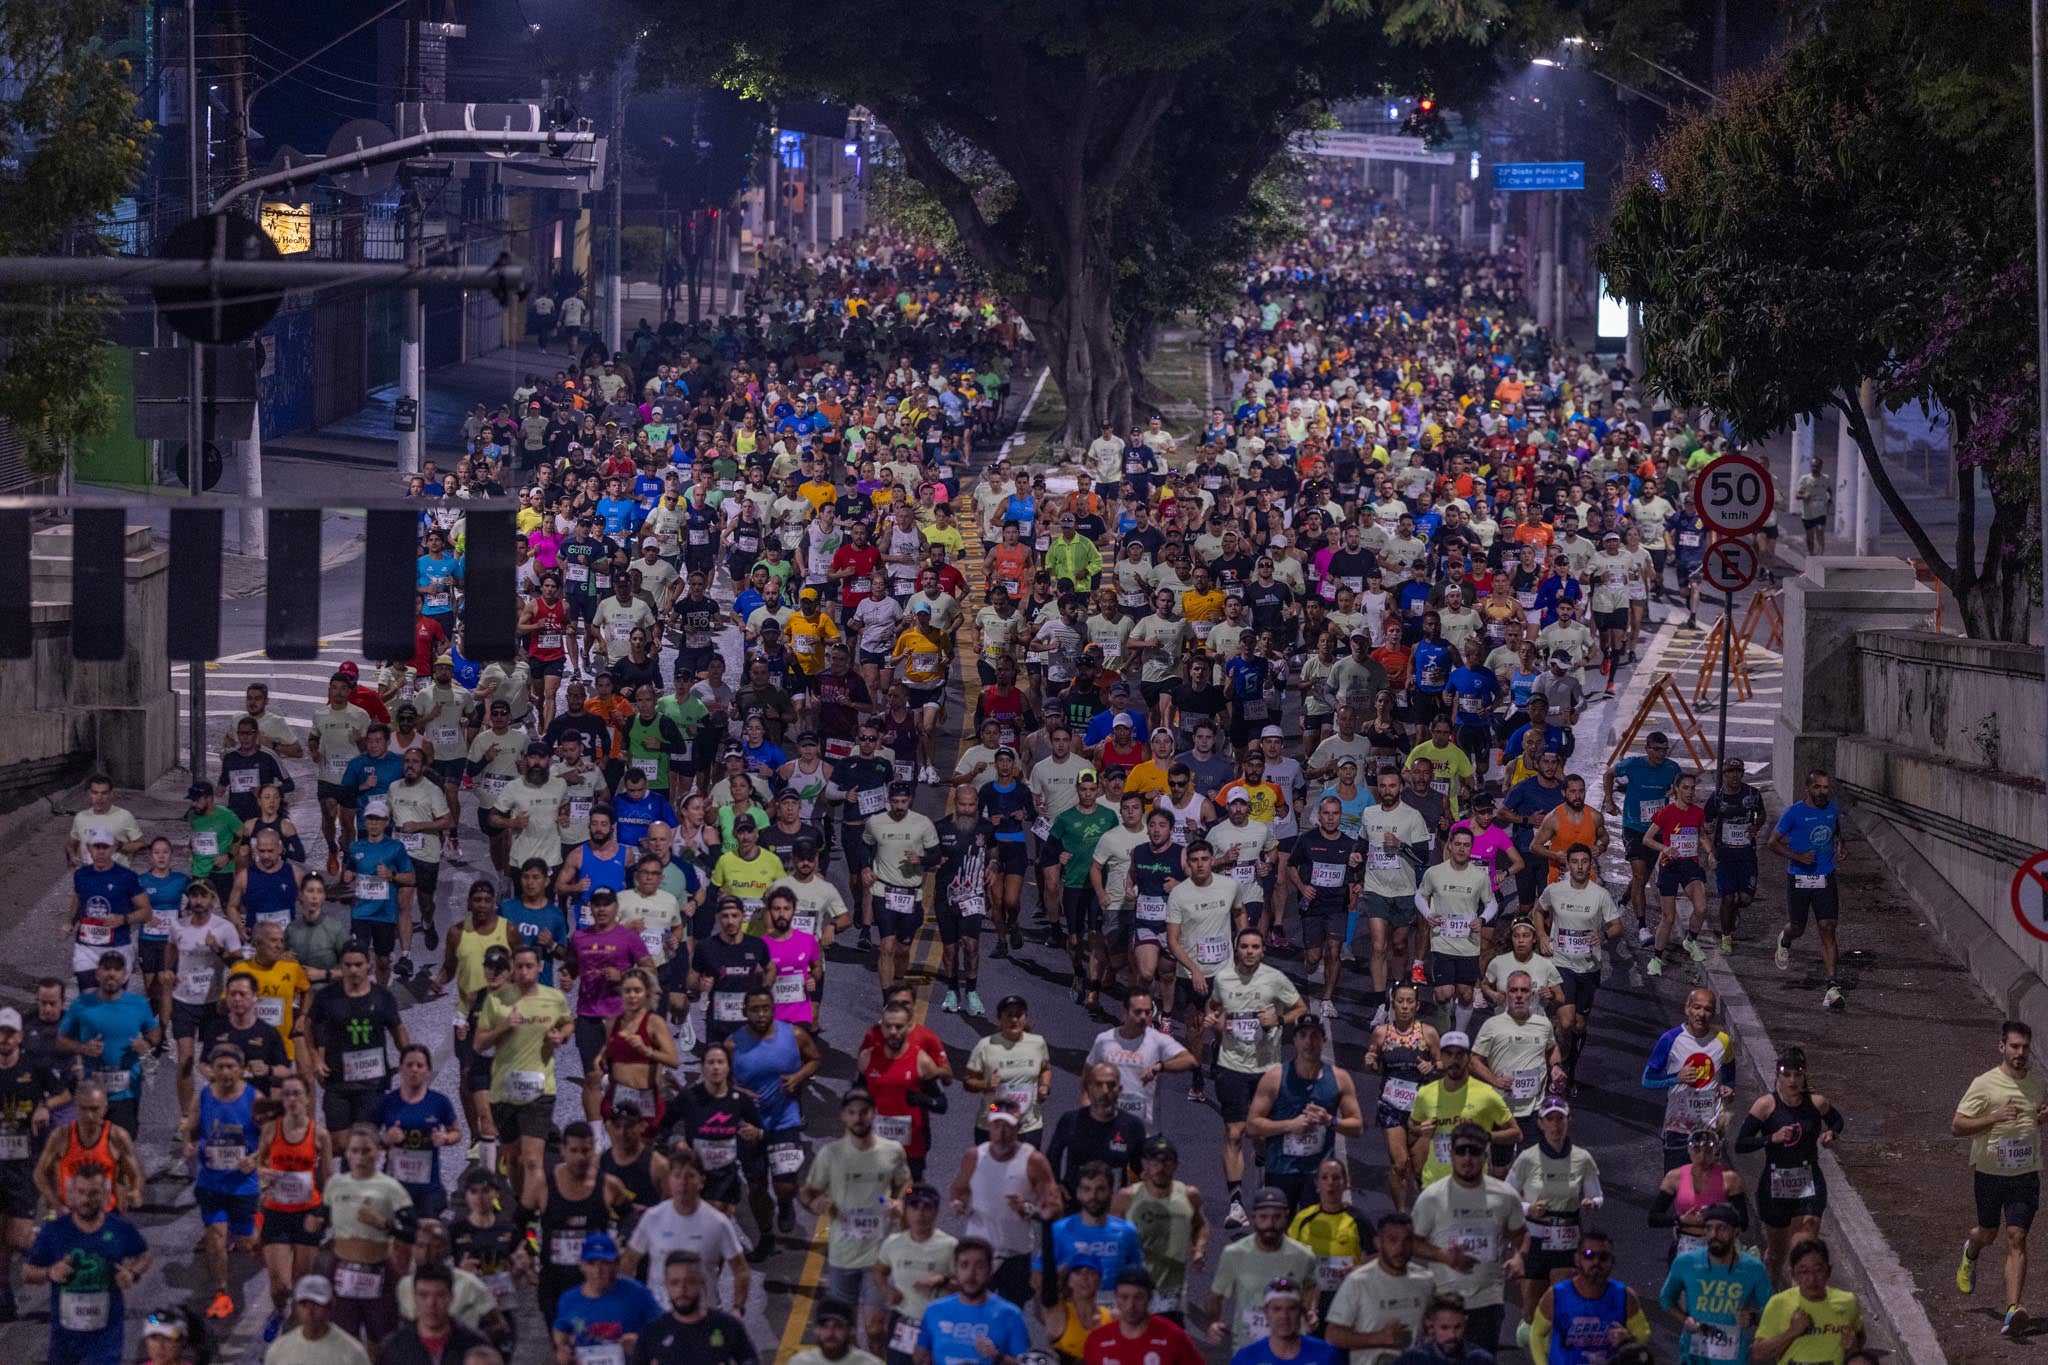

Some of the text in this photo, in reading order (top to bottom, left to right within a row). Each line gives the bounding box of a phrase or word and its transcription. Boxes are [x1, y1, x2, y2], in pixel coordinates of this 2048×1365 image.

[1710, 472, 1760, 506] 50
[1721, 510, 1749, 520] km/h
[1721, 550, 1741, 580] E
[1319, 870, 1341, 880] 21150
[894, 895, 911, 905] 1977
[1143, 903, 1165, 913] 10557
[1450, 920, 1468, 930] 9174
[1568, 937, 1586, 946] 1980
[1237, 1020, 1258, 1030] 1792
[1515, 1078, 1536, 1089] 8972
[1394, 1088, 1416, 1100] 9920
[1697, 1279, 1743, 1300] VEG
[1696, 1295, 1740, 1313] RUN
